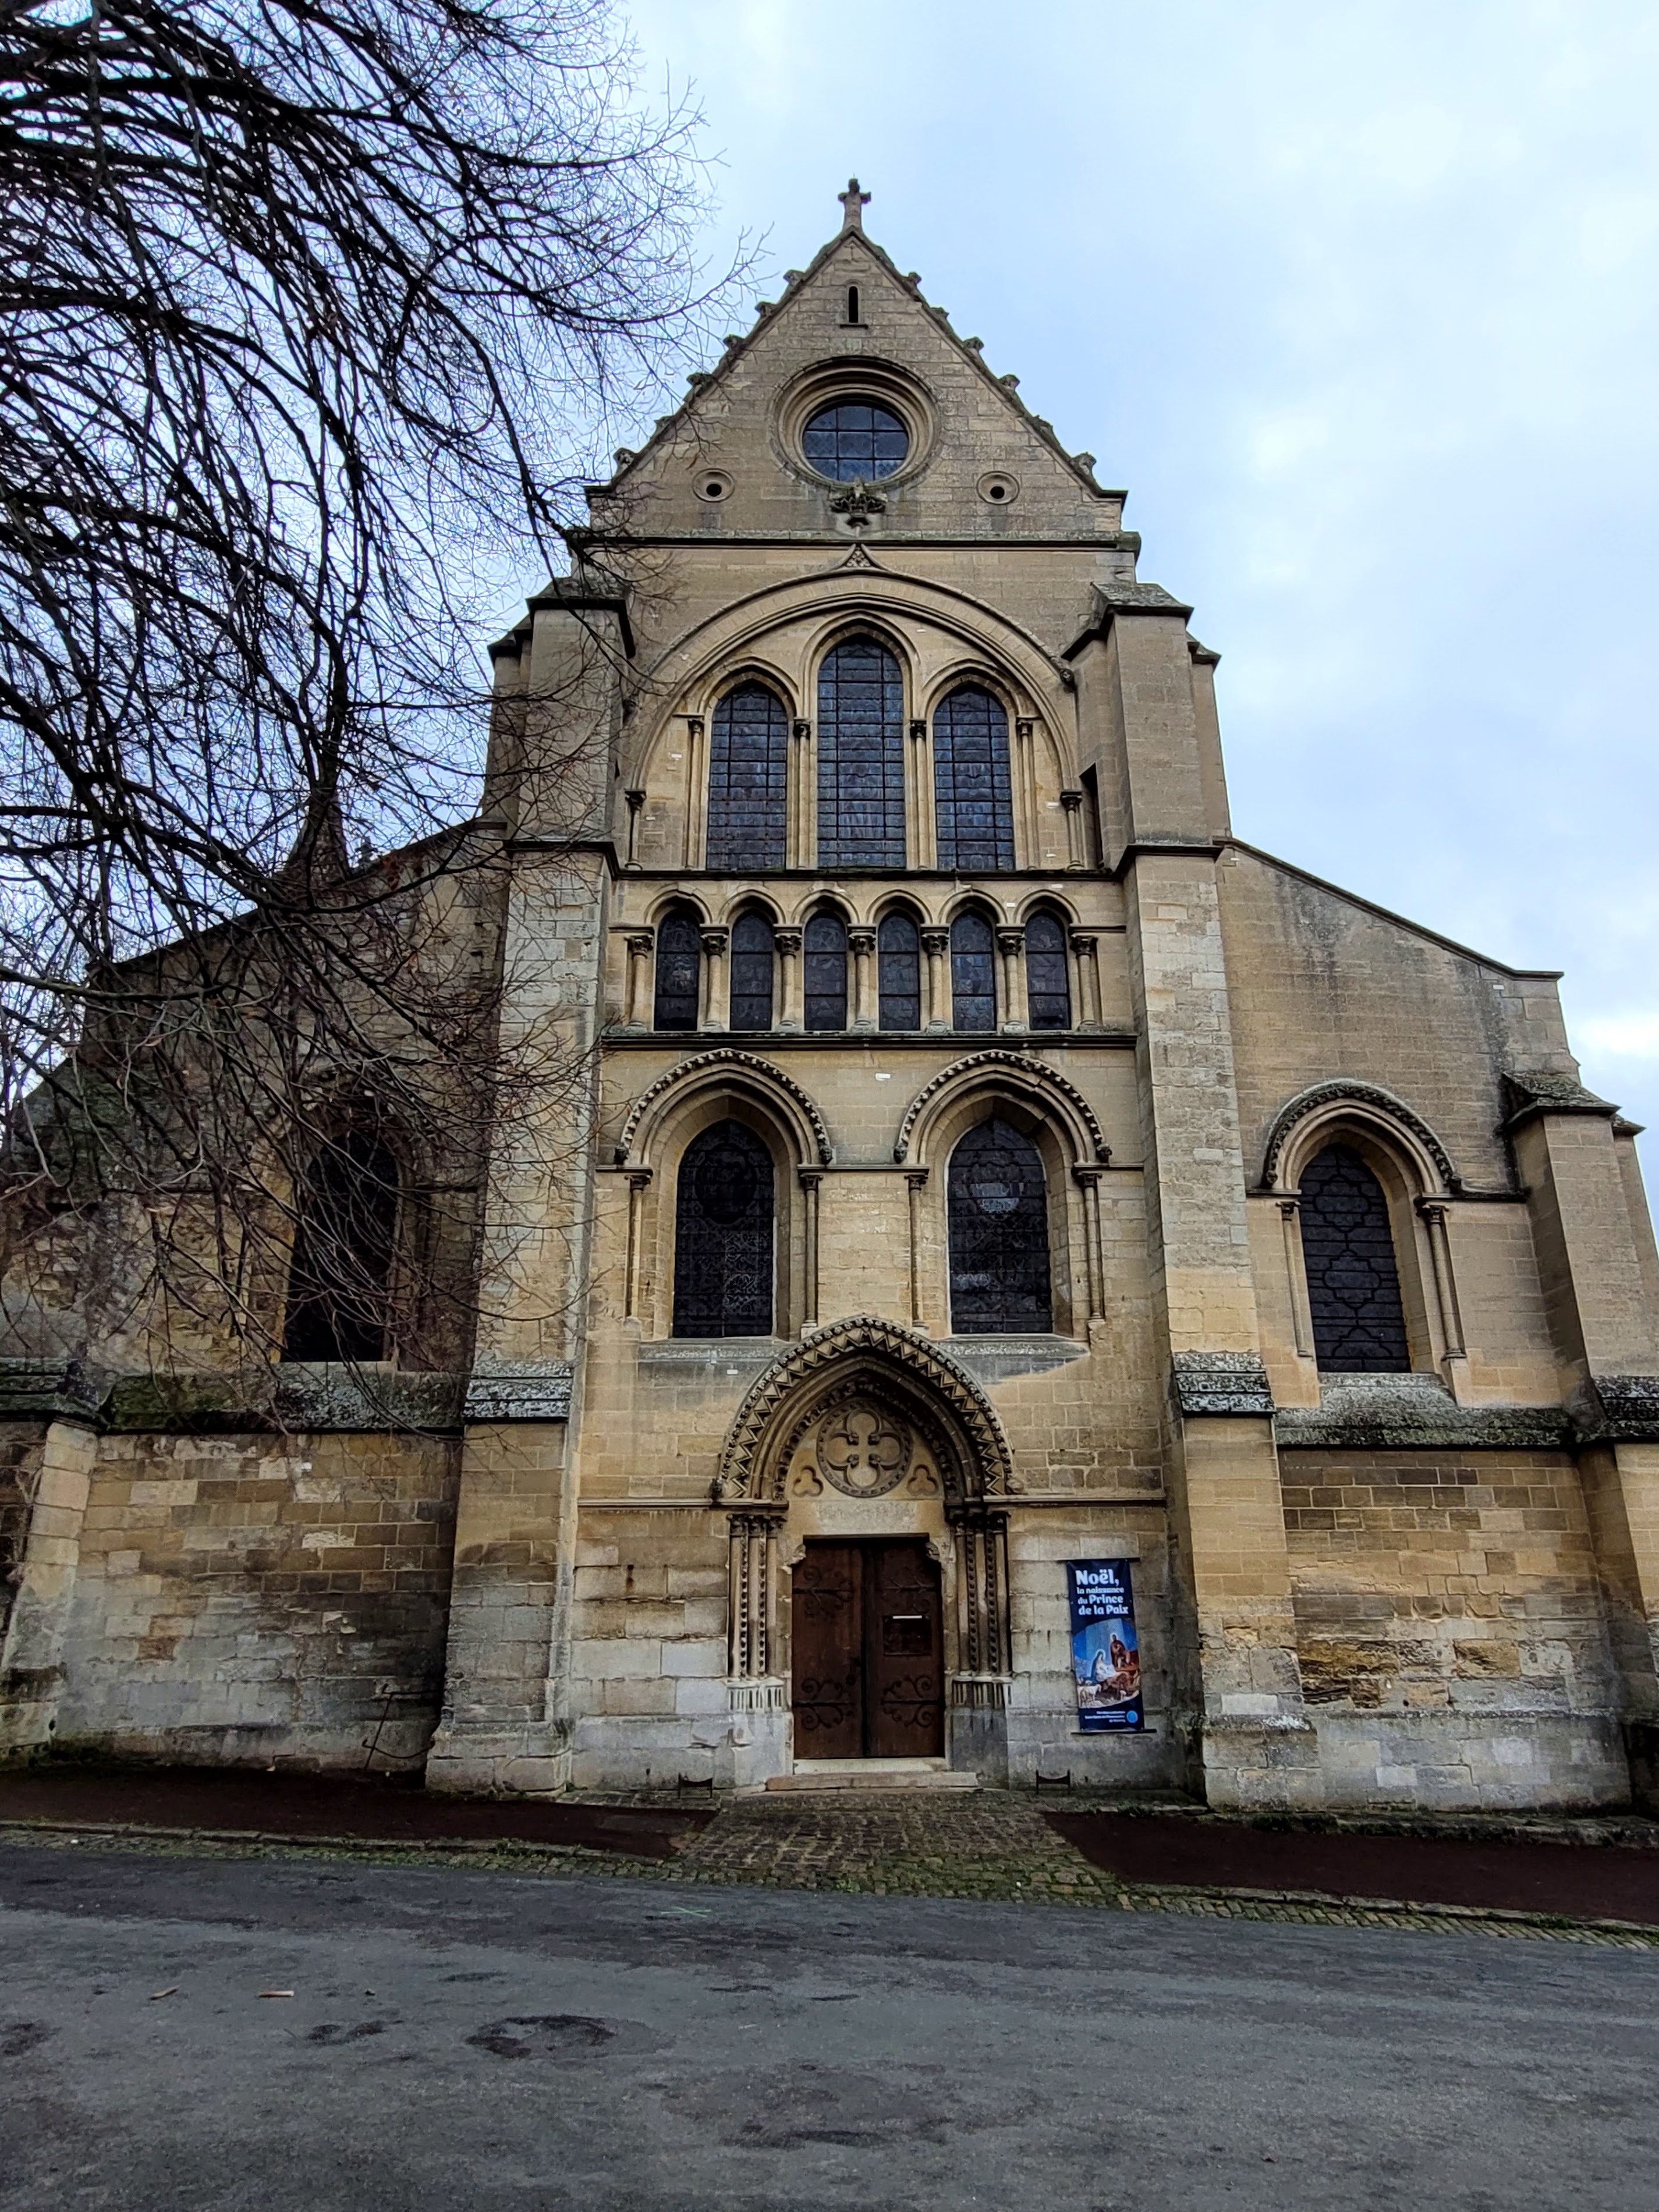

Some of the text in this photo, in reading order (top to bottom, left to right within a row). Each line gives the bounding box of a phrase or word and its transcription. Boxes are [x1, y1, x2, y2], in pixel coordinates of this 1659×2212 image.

[1075, 1569, 1119, 1587] Noël,
[1089, 1594, 1123, 1604] Prince
[1078, 1604, 1129, 1615] de la Paix
